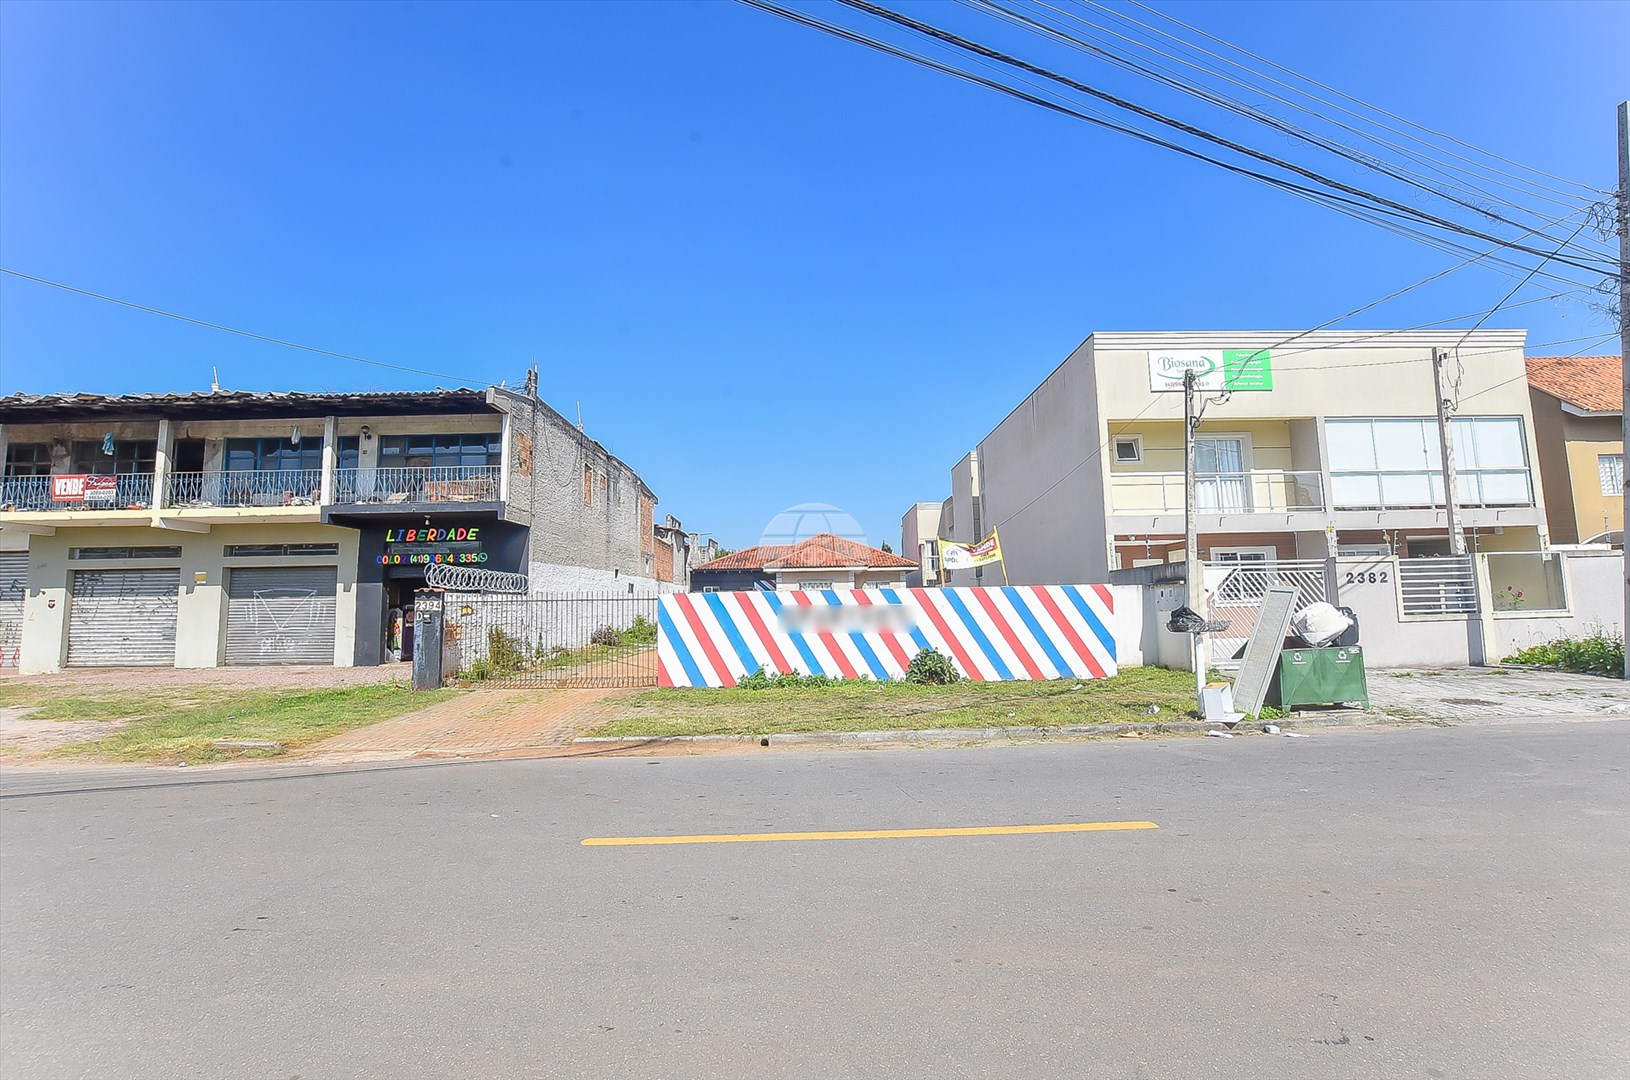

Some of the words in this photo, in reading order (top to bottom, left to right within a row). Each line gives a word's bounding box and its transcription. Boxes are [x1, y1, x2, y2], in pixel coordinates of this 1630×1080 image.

[1157, 356, 1206, 371] Biosana
[56, 479, 84, 495] VENDE
[386, 528, 480, 542] LIBERDADE
[1346, 571, 1388, 584] 2382
[415, 601, 441, 610] 2394
